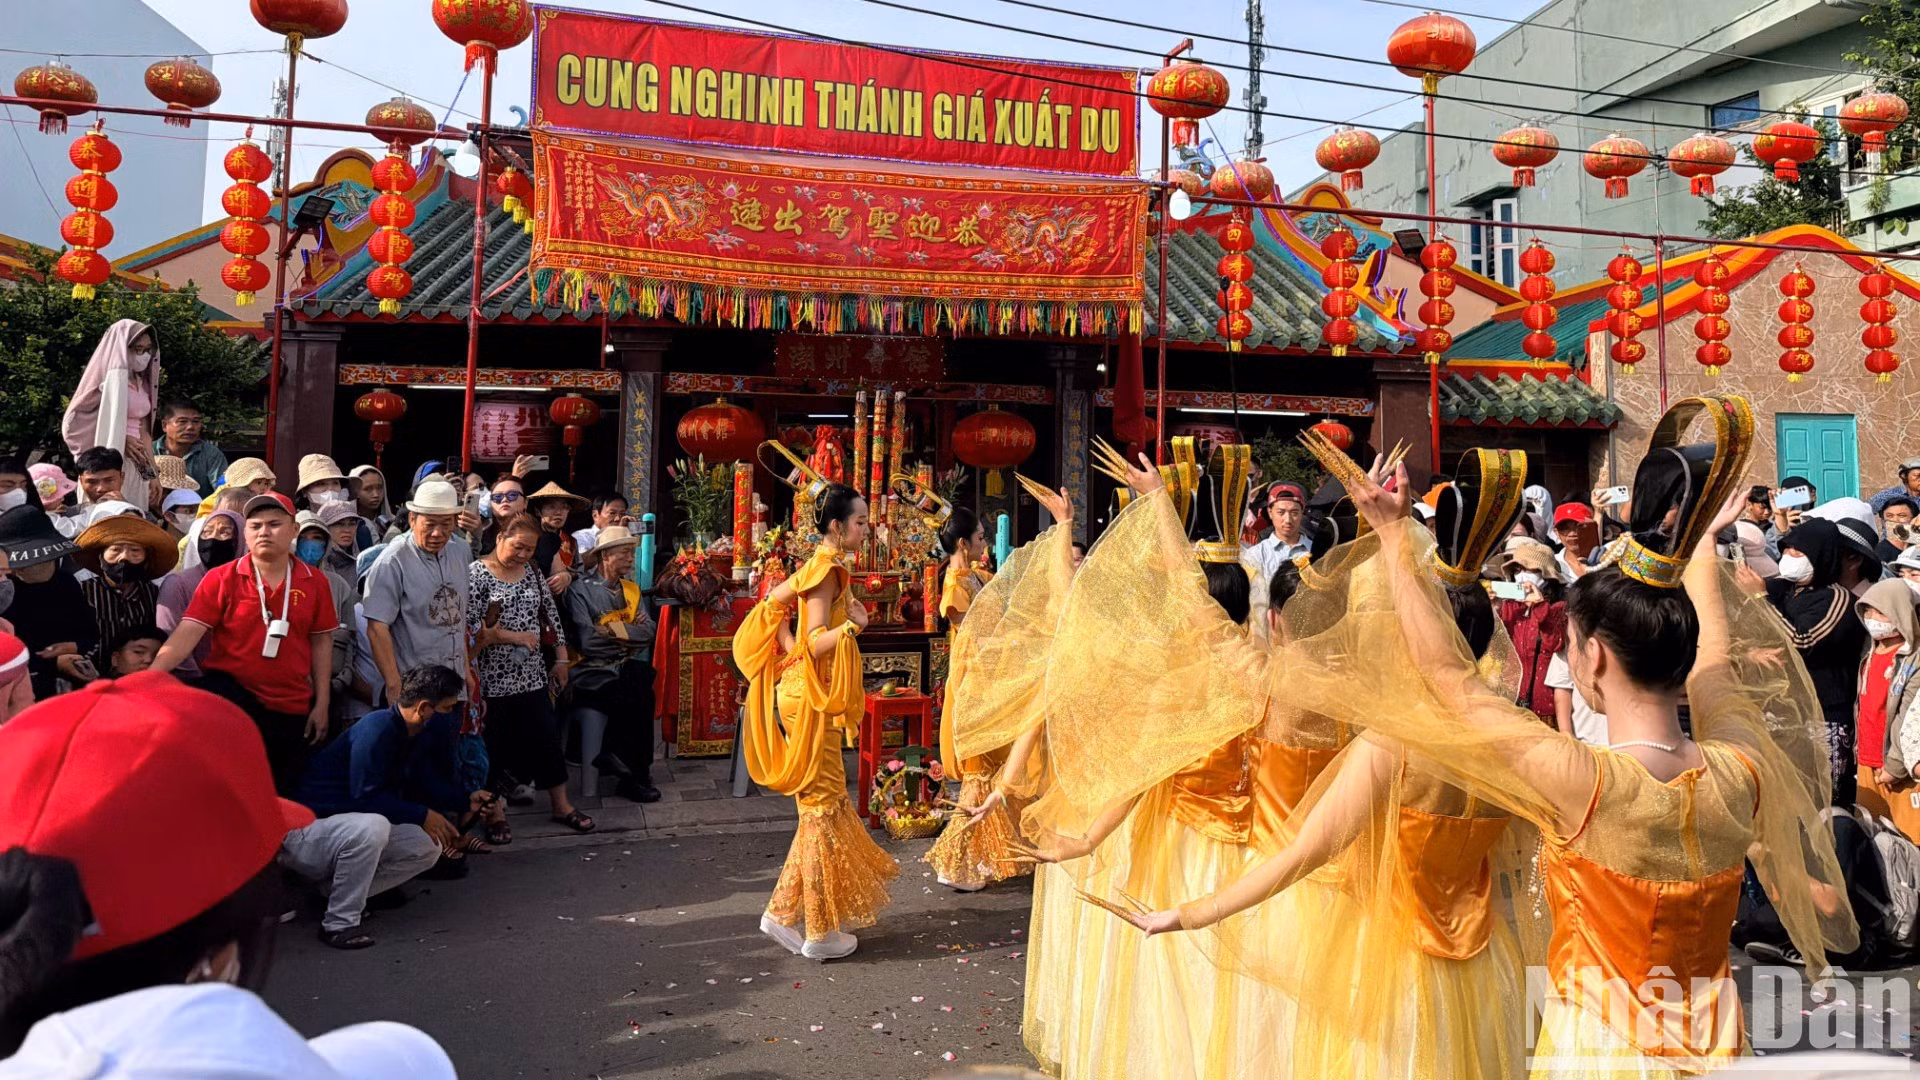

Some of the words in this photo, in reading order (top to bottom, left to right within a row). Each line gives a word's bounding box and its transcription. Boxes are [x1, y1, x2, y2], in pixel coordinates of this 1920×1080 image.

[556, 53, 660, 113] CUNG
[669, 64, 805, 127] NGHINH
[813, 78, 924, 138] THÁNH
[932, 88, 987, 143] GIÁ
[993, 87, 1074, 150] XUẤT
[1079, 105, 1121, 155] DU
